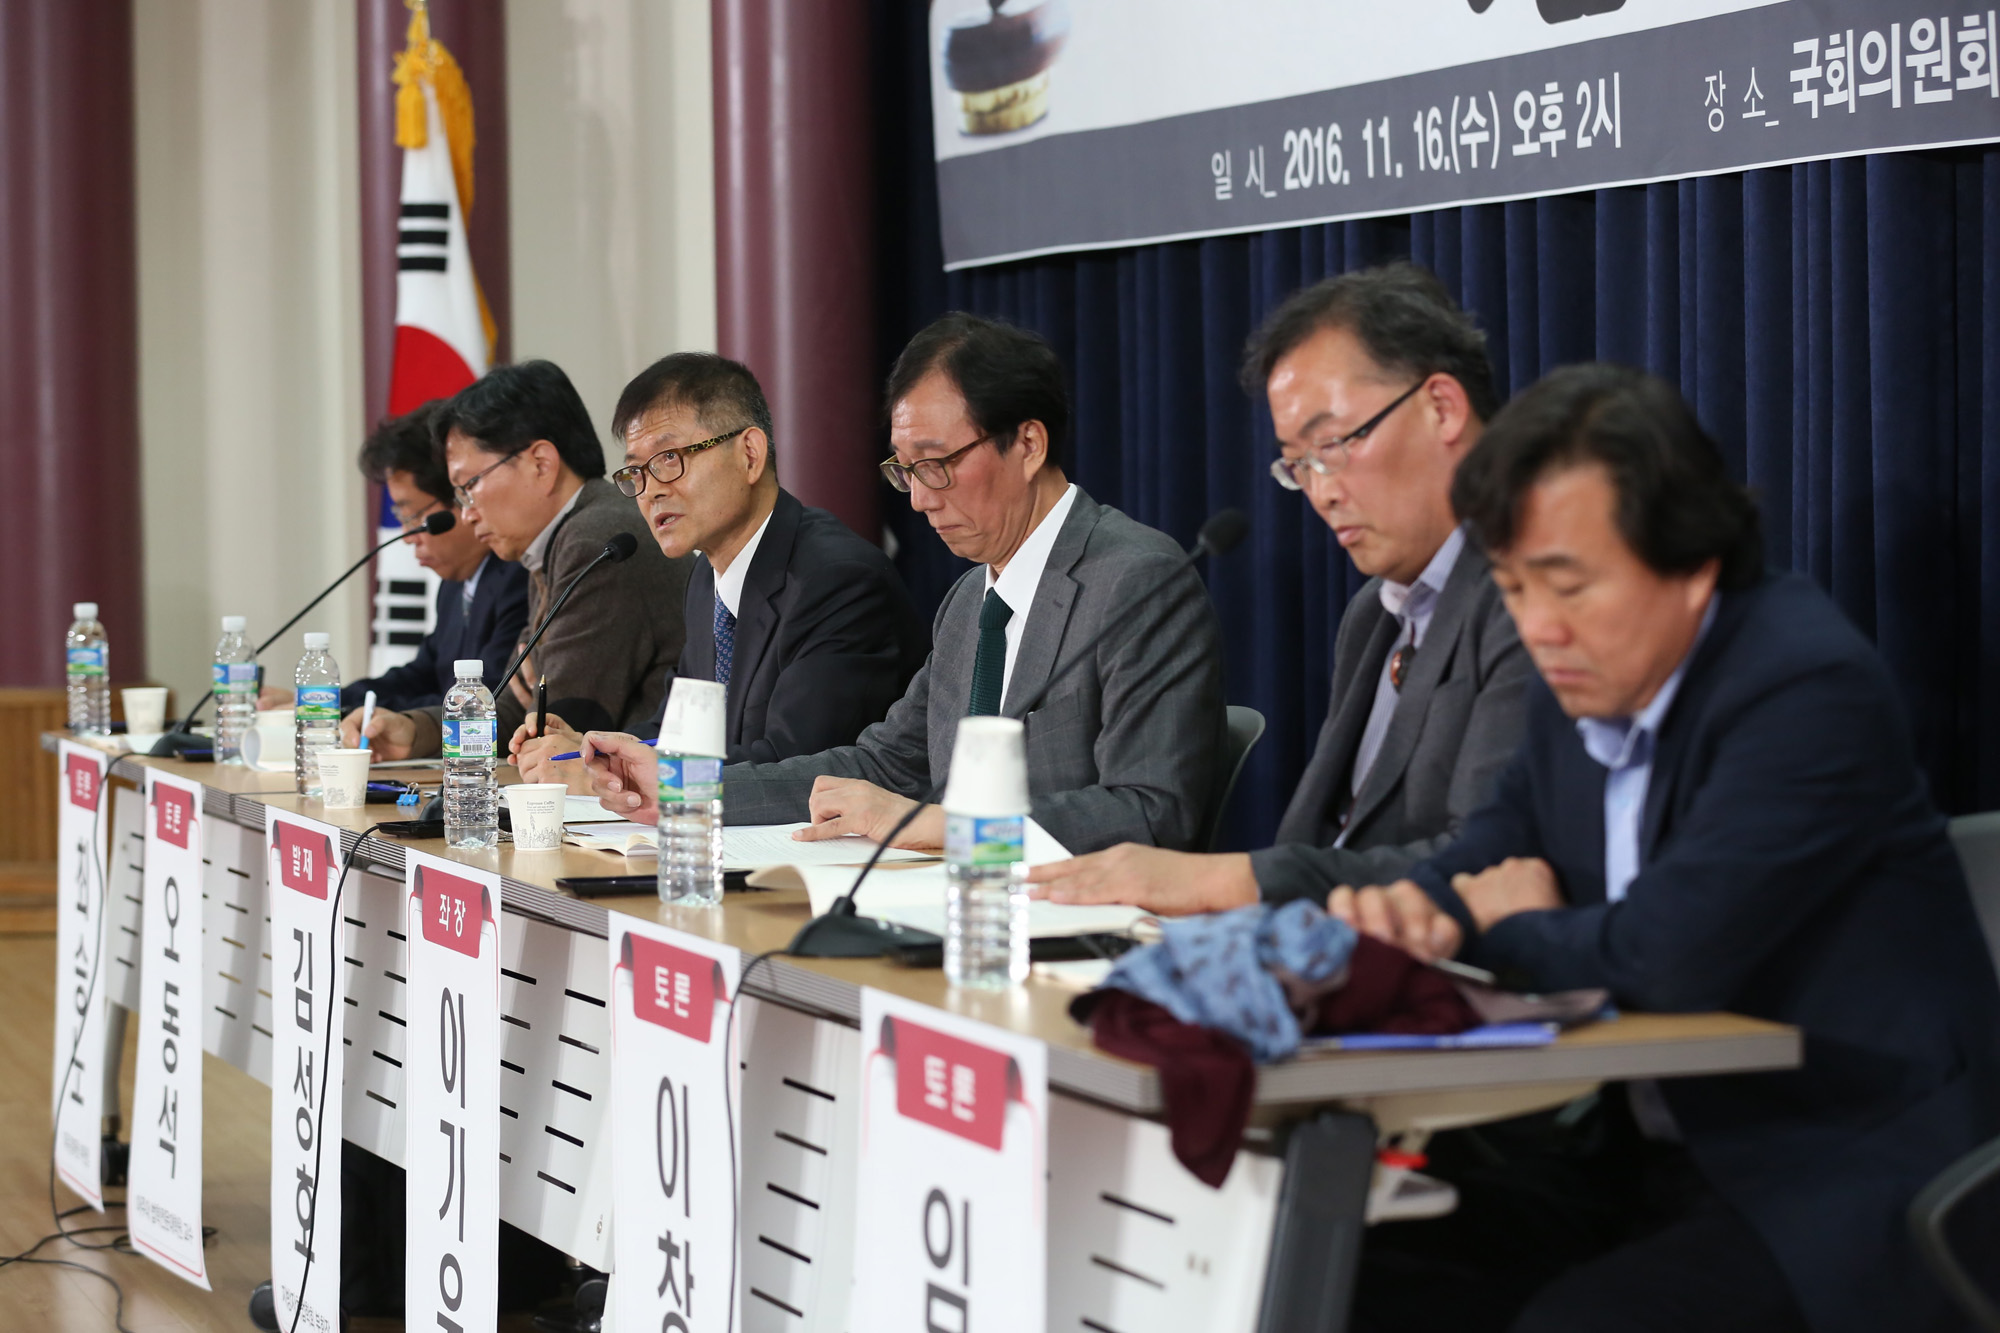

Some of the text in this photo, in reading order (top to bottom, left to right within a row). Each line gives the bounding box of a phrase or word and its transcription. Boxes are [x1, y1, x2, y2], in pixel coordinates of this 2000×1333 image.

[1789, 9, 2000, 119] 국회의원회
[1283, 122, 1350, 191] 2016.
[1361, 115, 1403, 179] 11.
[1511, 81, 1567, 158] 오후
[1575, 71, 1621, 149] 2시
[165, 800, 182, 834] 토론
[291, 843, 314, 883] 발제
[438, 893, 468, 939] 좌장
[157, 875, 181, 1181] 오동석
[654, 964, 693, 1020] 토론
[292, 927, 317, 1265] 김성호
[922, 1053, 978, 1124] 토론
[656, 1075, 696, 1333] 이창
[922, 1186, 971, 1333] 임
